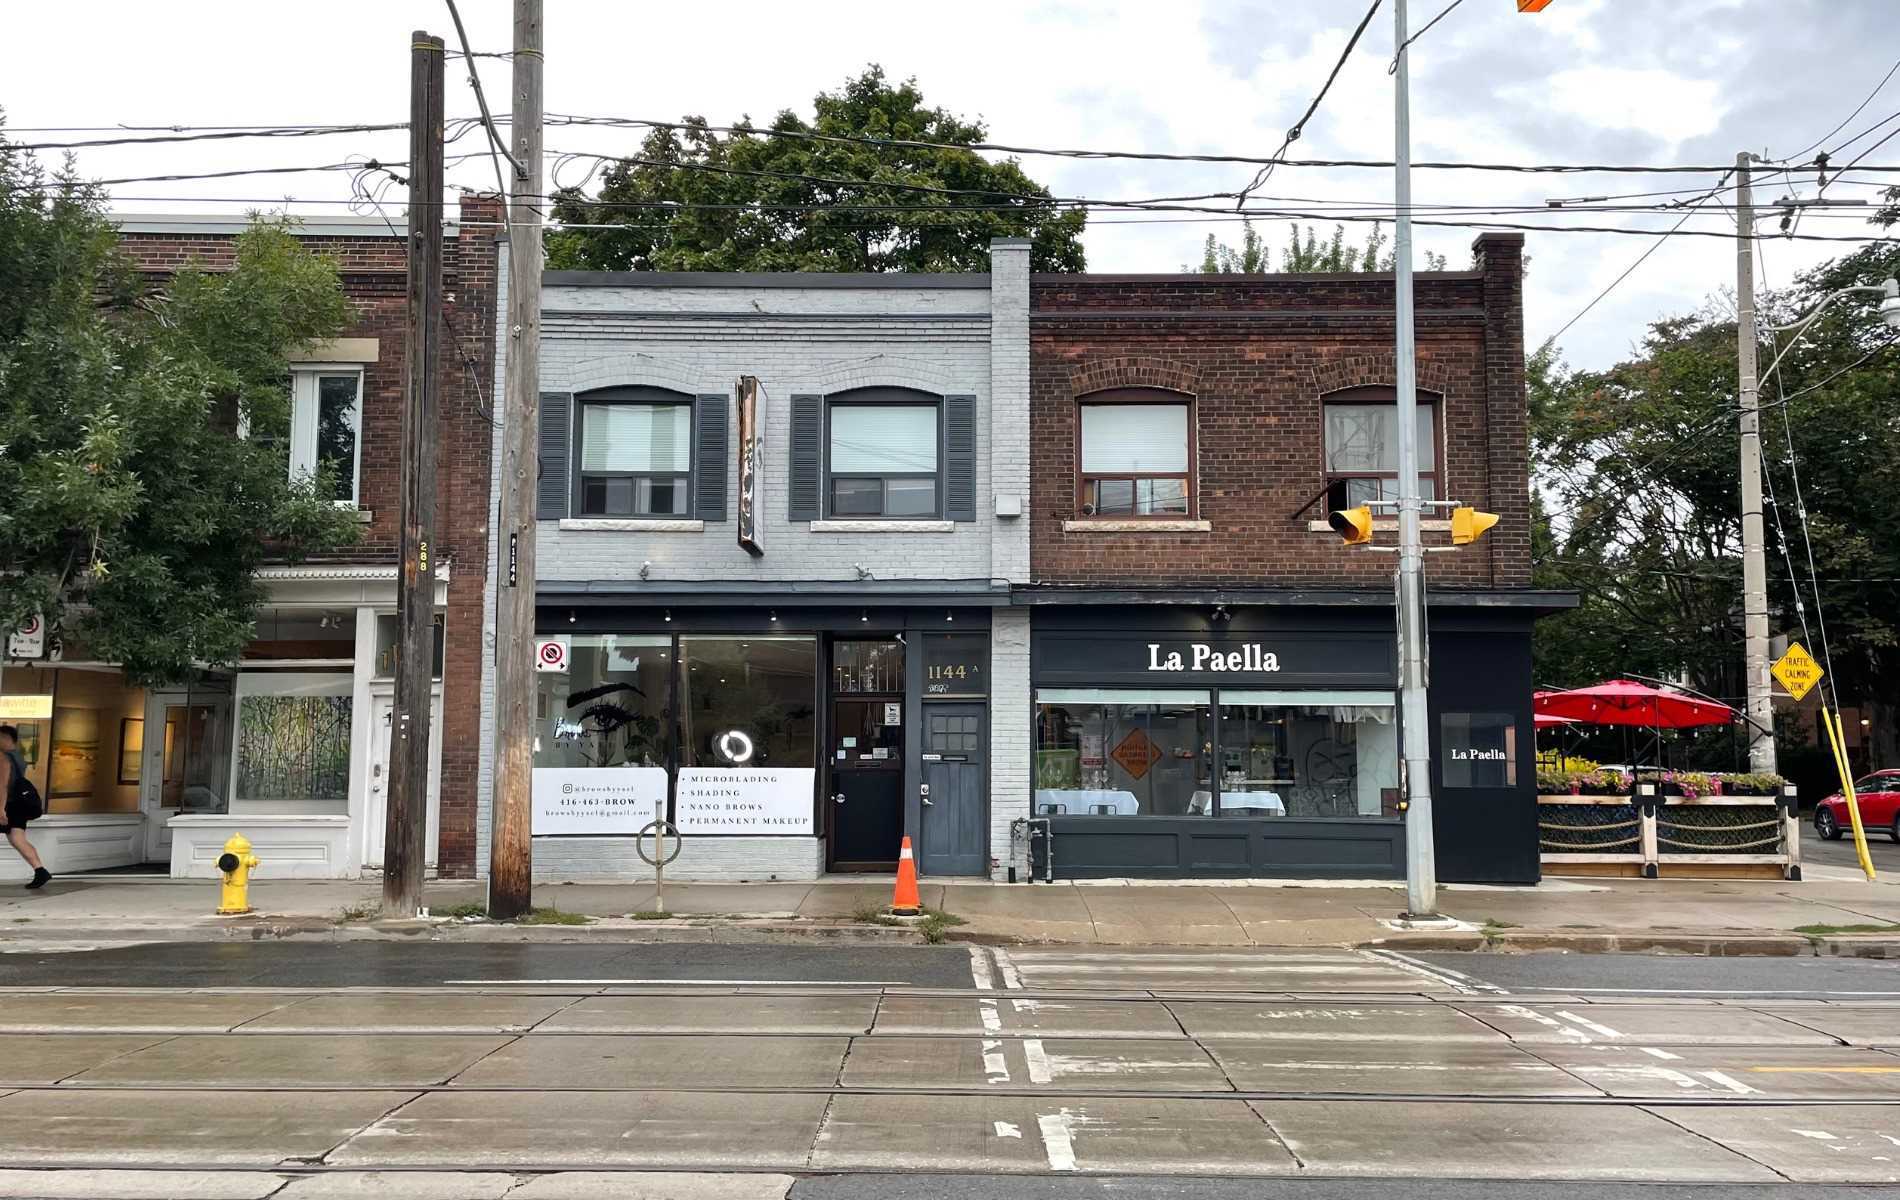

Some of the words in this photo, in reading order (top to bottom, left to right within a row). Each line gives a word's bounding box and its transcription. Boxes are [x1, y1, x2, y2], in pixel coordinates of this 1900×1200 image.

[420, 542, 428, 571] 288
[1147, 644, 1184, 671] La
[1191, 643, 1280, 672] Paella
[1785, 657, 1809, 667] TRAFFIC
[928, 665, 967, 679] 1144
[1784, 669, 1811, 679] CALMING
[1790, 682, 1805, 691] ZONE
[1451, 749, 1467, 760] La
[1469, 749, 1506, 760] Paella
[690, 789, 740, 797] SHADING
[688, 817, 757, 825] PERMANENT
[762, 817, 808, 825] MAKEUP
